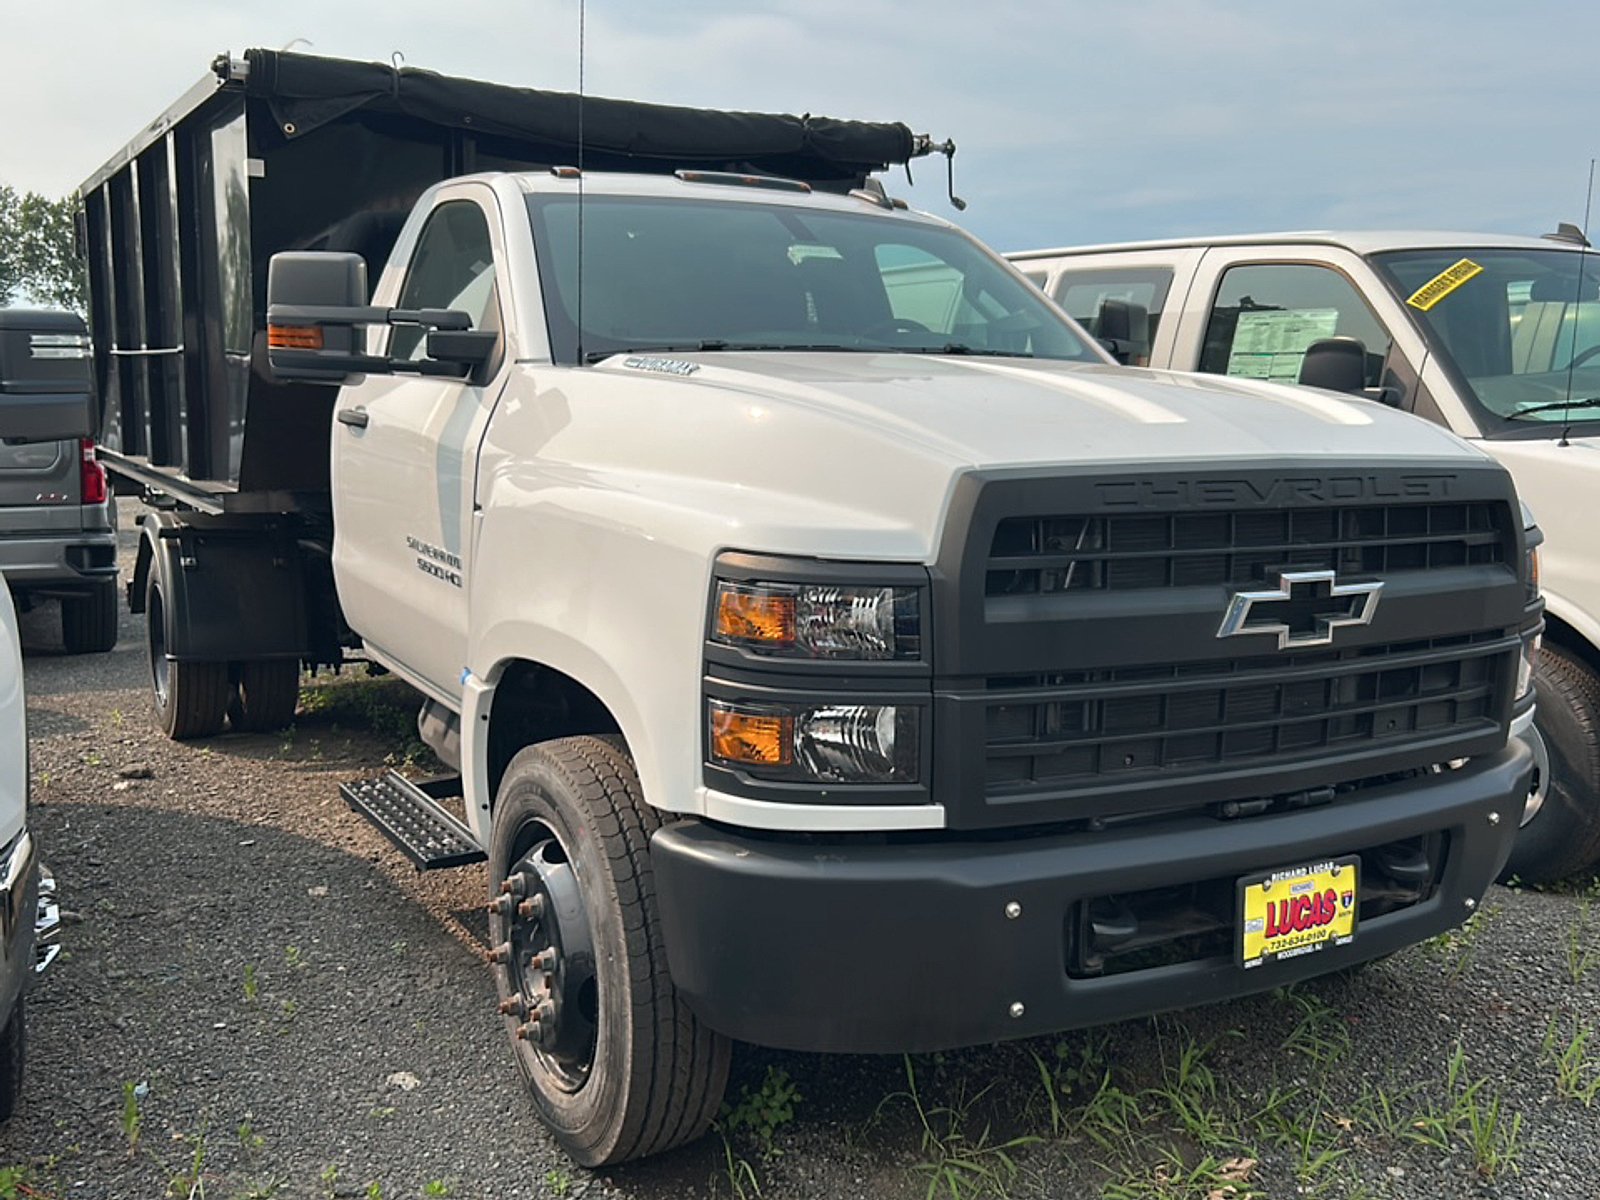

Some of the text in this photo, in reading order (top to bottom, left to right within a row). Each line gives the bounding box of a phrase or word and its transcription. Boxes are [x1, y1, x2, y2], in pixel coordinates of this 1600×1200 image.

[1095, 474, 1458, 506] CHEVROLET
[1271, 861, 1335, 881] RICHARD LUCAS
[1264, 888, 1338, 939] LUCAS
